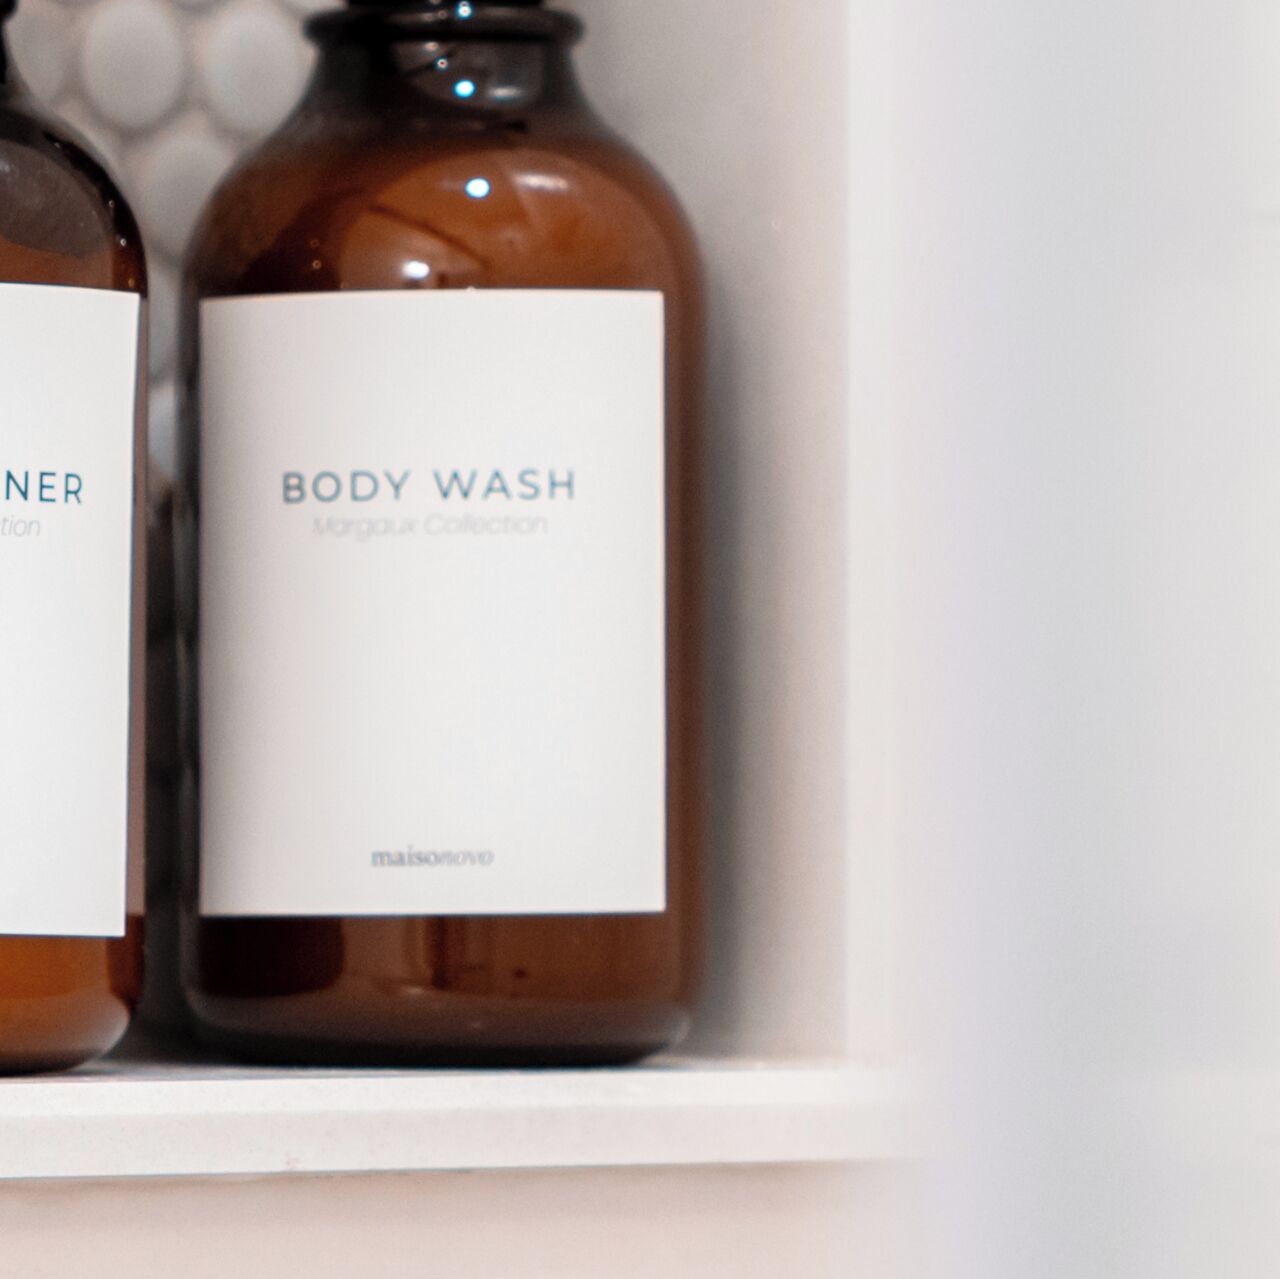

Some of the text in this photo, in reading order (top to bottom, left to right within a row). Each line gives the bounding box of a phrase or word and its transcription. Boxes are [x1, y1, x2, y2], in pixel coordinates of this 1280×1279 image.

[281, 468, 576, 505] BODY WASH
[312, 514, 549, 543] Margaux Collection
